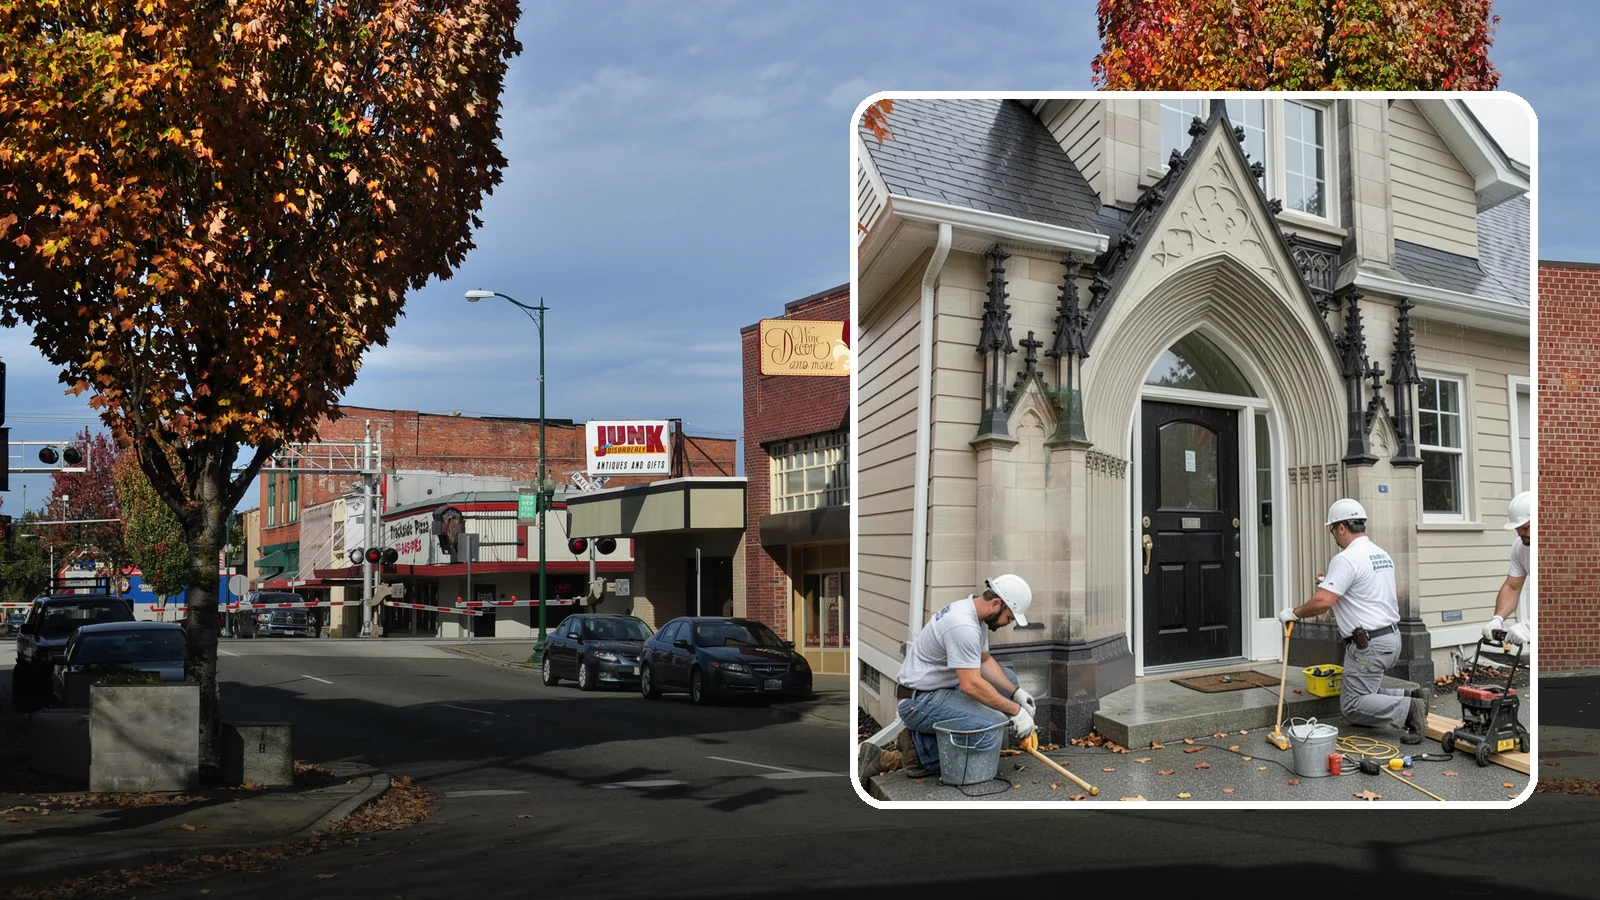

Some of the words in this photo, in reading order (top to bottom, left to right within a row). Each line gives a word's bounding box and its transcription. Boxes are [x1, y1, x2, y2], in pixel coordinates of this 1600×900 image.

[596, 425, 664, 457] JUNK
[607, 446, 645, 454] DISORDERLY
[597, 461, 628, 470] ANTIQUES
[631, 461, 643, 469] AND
[647, 460, 665, 469] GIFTS
[390, 521, 413, 539] Trackside
[414, 519, 429, 535] Pizza
